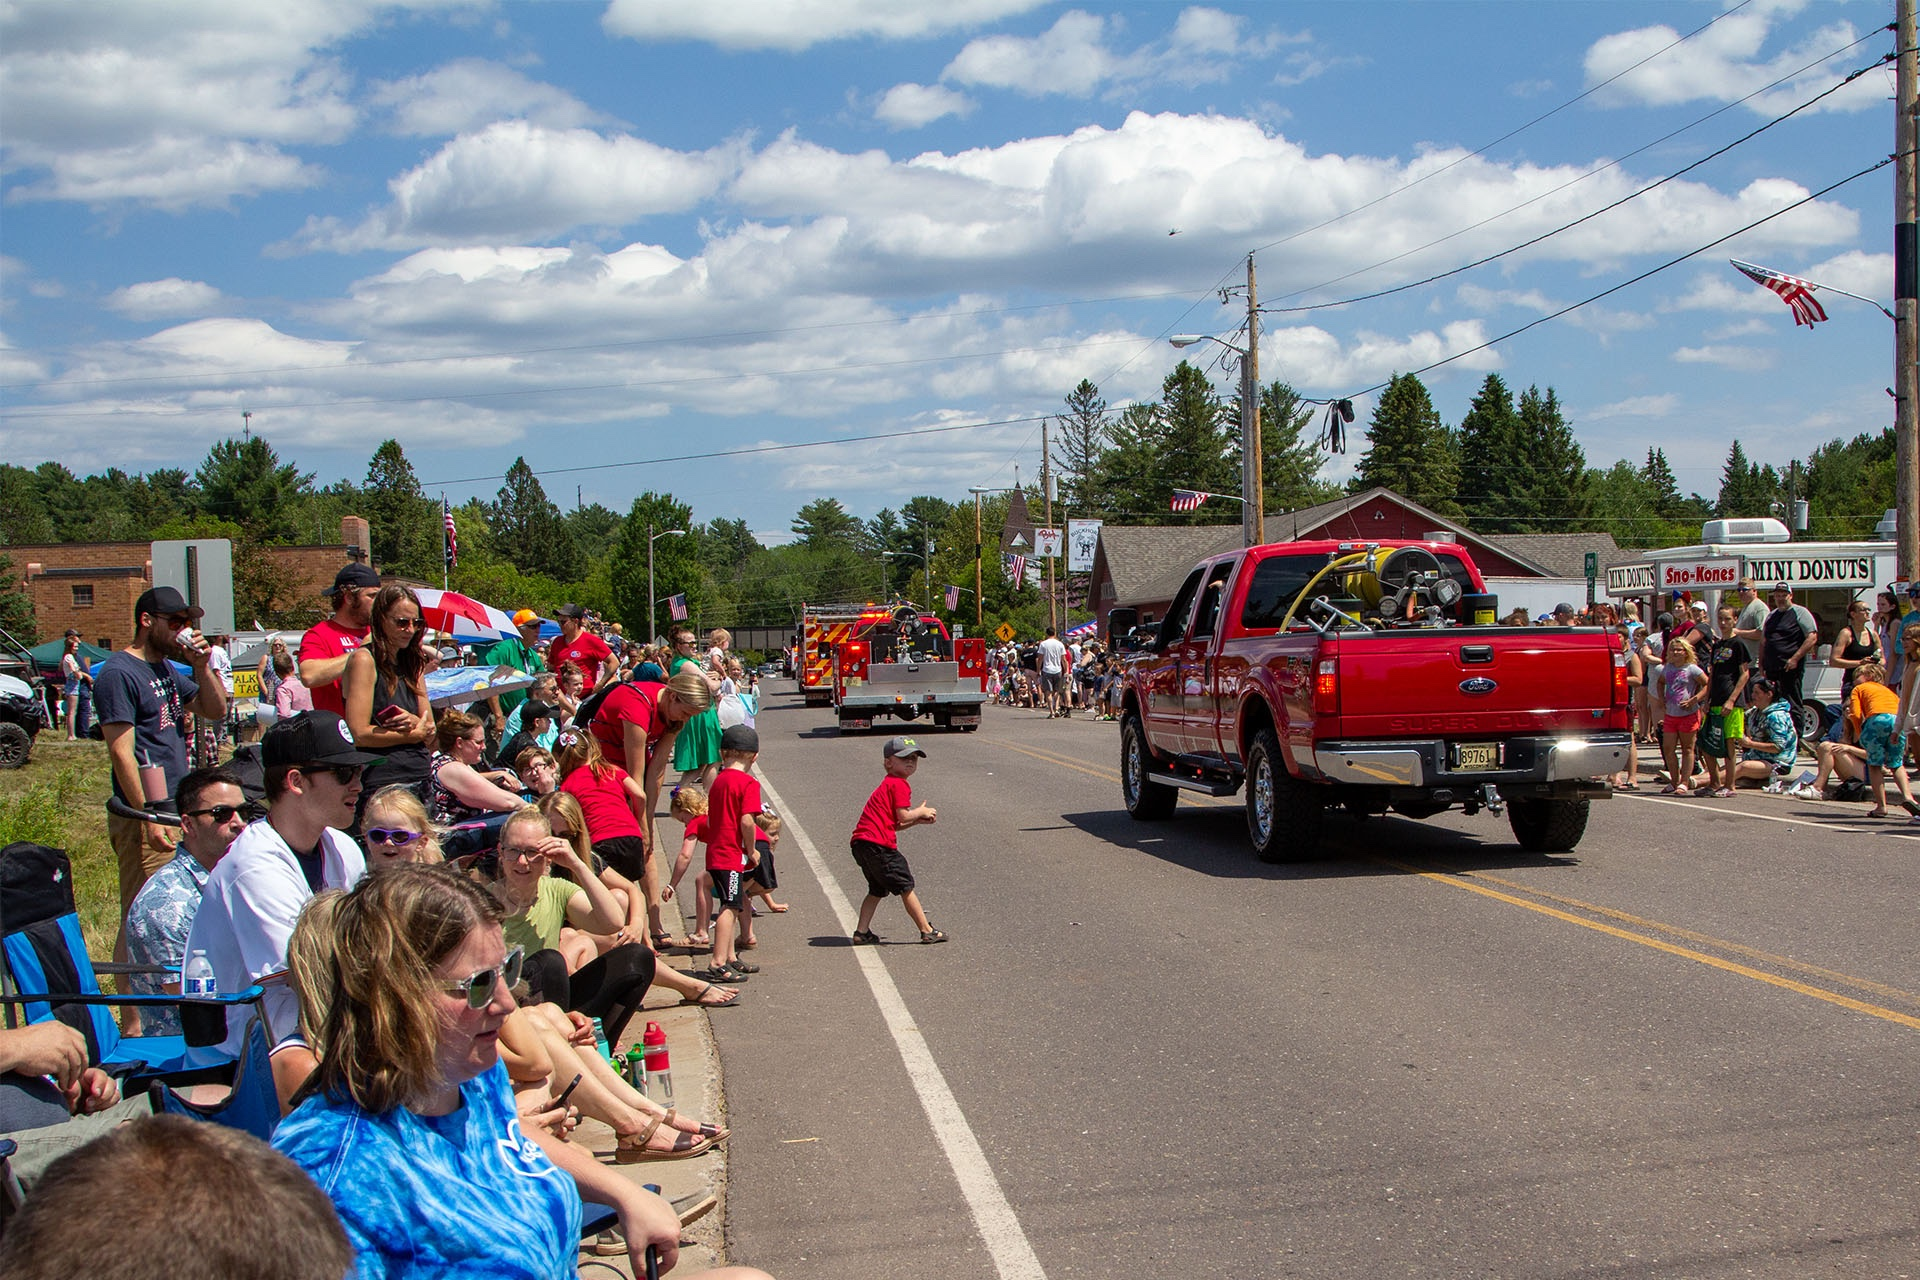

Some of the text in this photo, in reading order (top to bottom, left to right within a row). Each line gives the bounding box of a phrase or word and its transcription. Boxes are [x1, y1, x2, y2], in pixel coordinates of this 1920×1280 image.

[1609, 566, 1655, 588] MINI DONUTS
[1665, 565, 1735, 584] Sno-Kones
[1751, 558, 1869, 581] MINI DONUTS
[1468, 679, 1489, 690] Ford
[1391, 716, 1479, 732] SUPER
[1461, 749, 1490, 764] 89761
